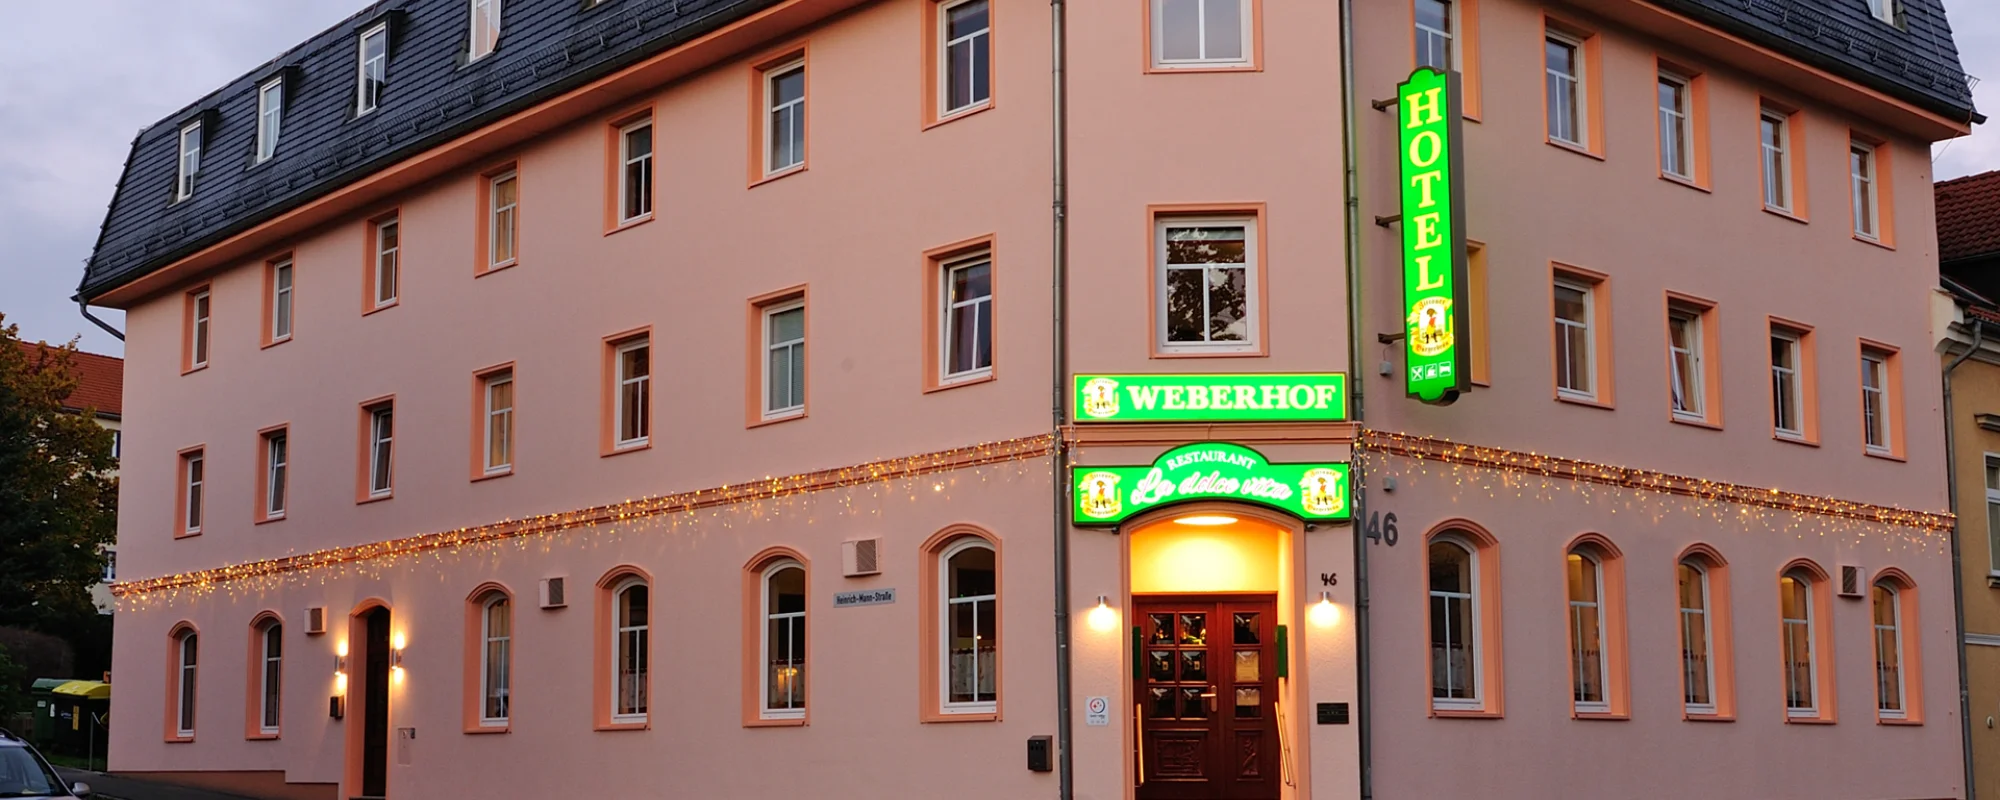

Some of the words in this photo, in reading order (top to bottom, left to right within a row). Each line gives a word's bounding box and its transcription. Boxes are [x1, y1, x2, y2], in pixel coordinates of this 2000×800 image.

[1406, 87, 1444, 292] HOTEL
[1126, 384, 1336, 410] WEBERHOF
[1166, 450, 1257, 471] RESTAURANT
[1130, 467, 1177, 506] La
[1178, 470, 1240, 495] dolce
[1240, 476, 1293, 501] vita
[1366, 510, 1398, 546] 46
[1321, 572, 1337, 586] 46
[836, 591, 892, 605] Heinrich-Mann-Straße
